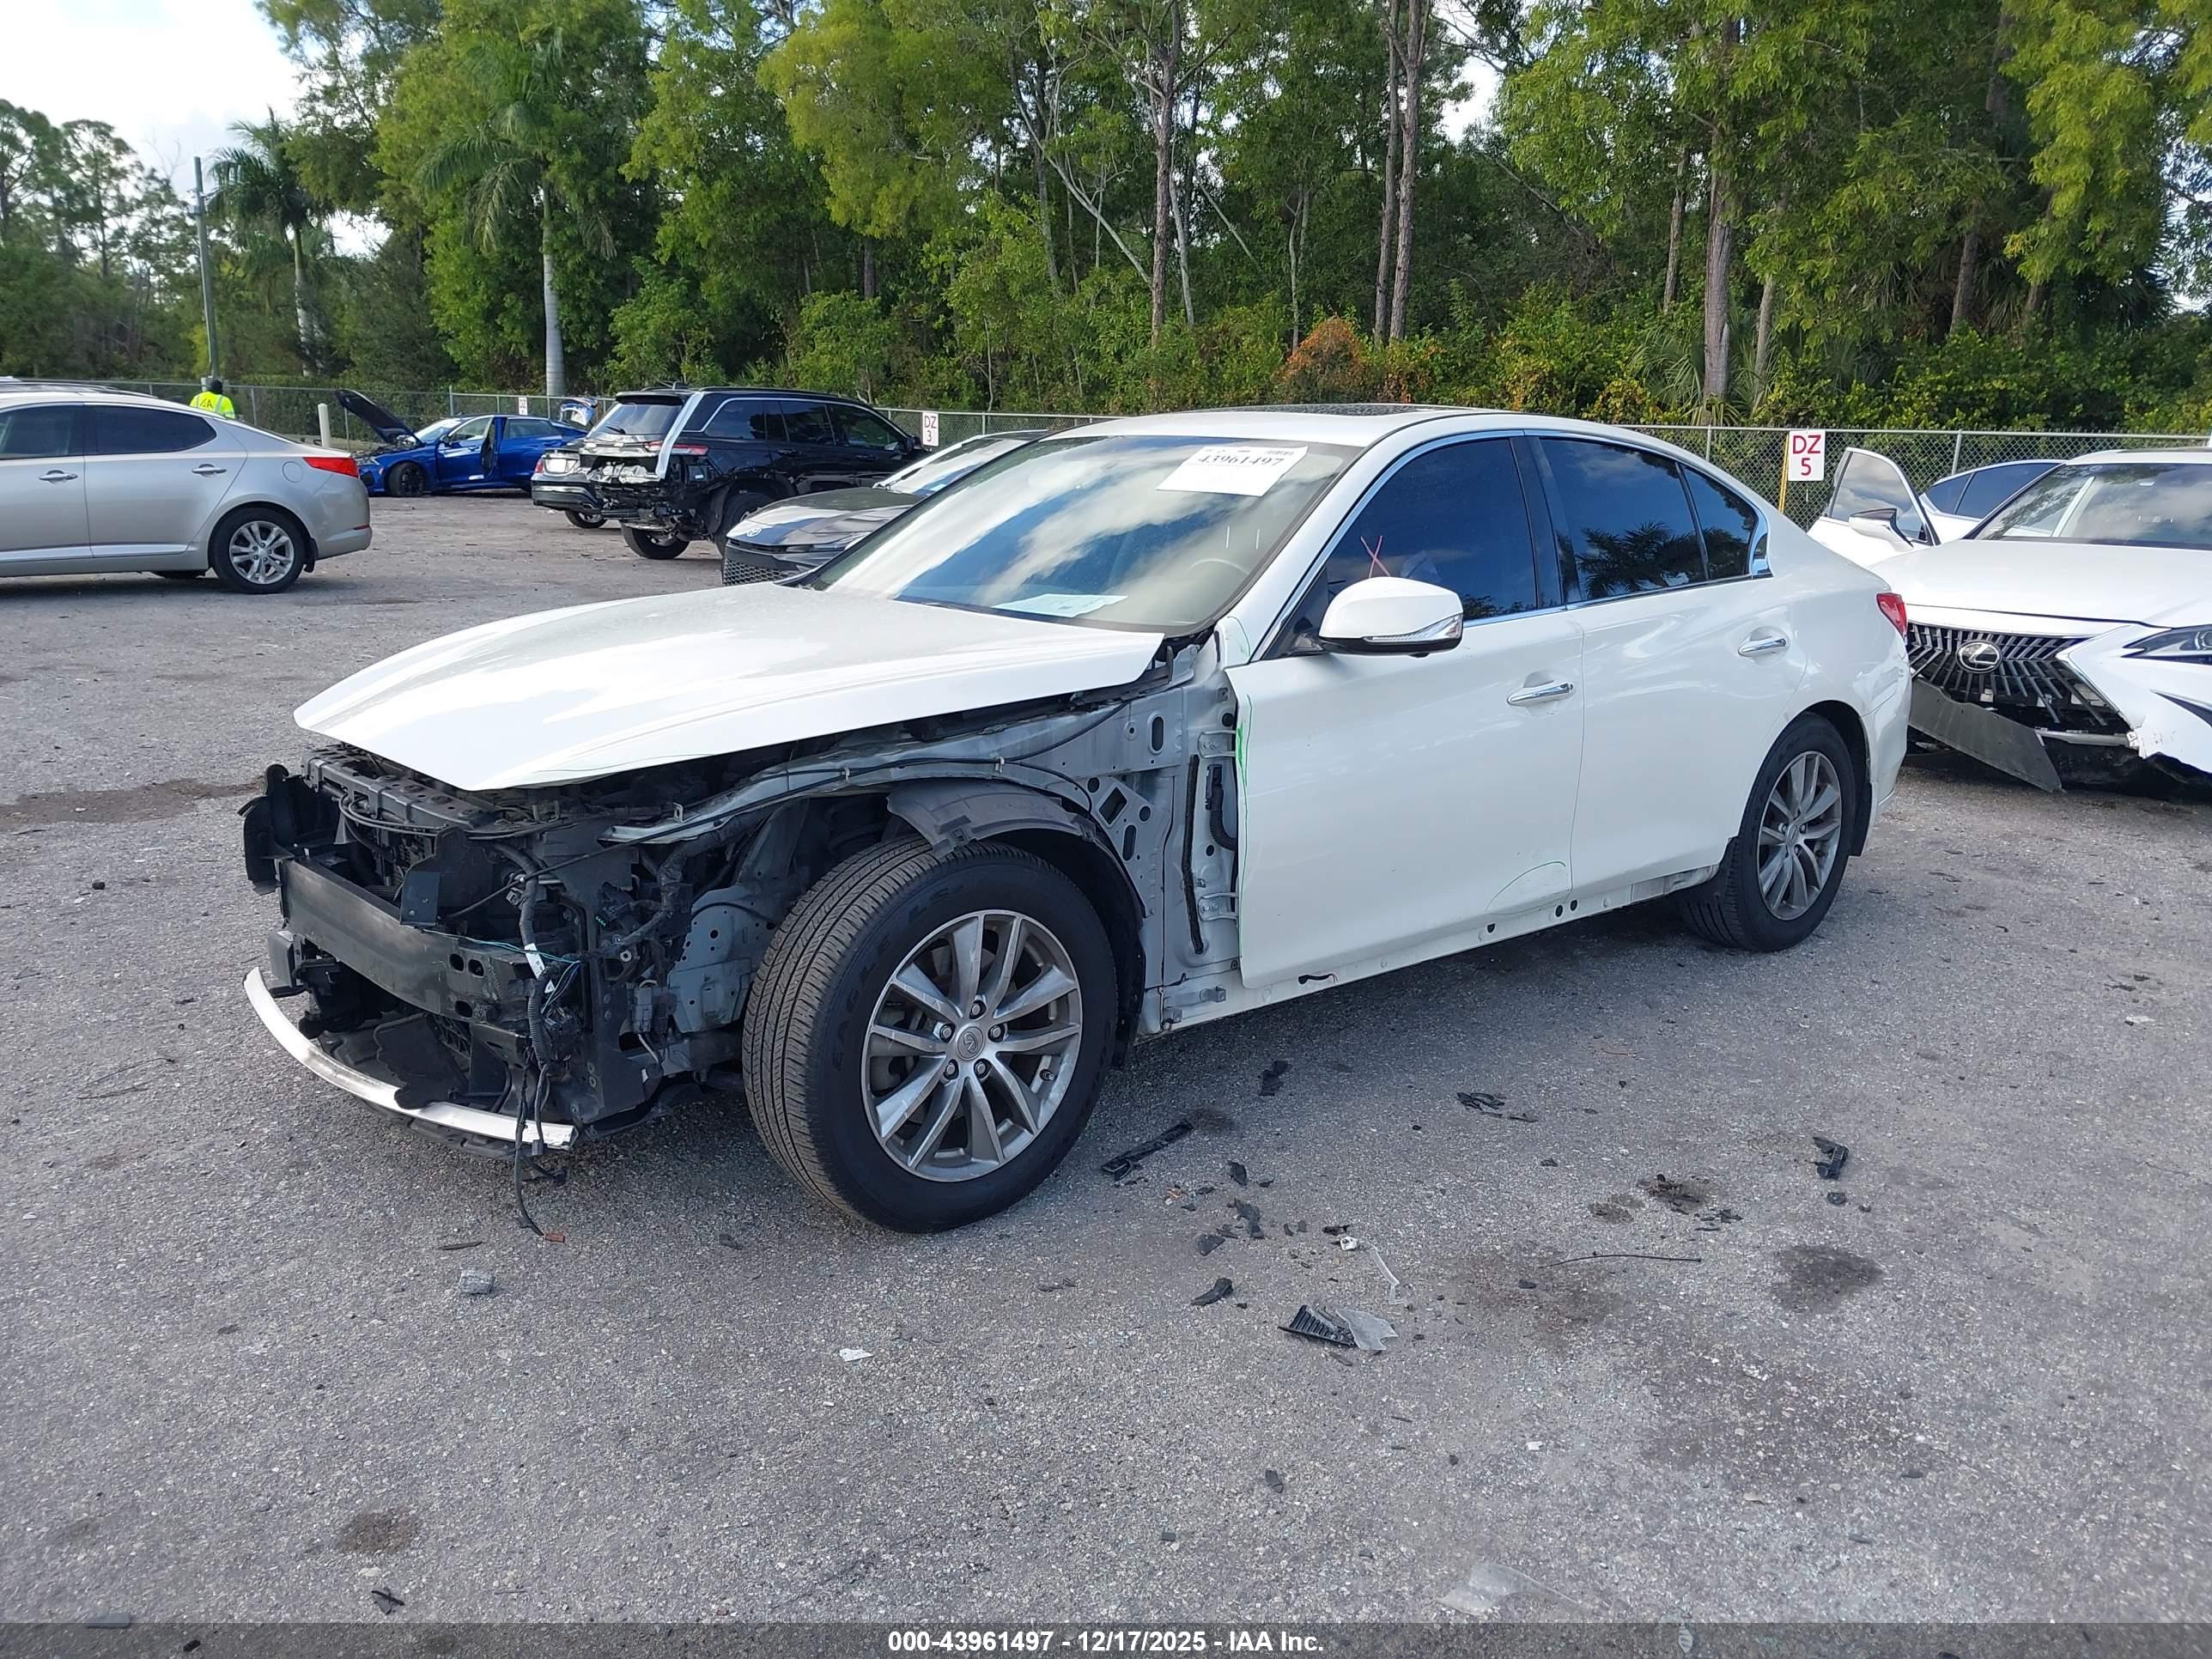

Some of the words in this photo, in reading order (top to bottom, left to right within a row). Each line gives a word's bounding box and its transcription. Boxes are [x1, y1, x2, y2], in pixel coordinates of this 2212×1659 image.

[924, 415, 937, 428] DZ
[927, 429, 933, 442] 3
[1792, 434, 1821, 454] DZ
[1198, 454, 1285, 466] 43961497
[1800, 458, 1812, 476] 5
